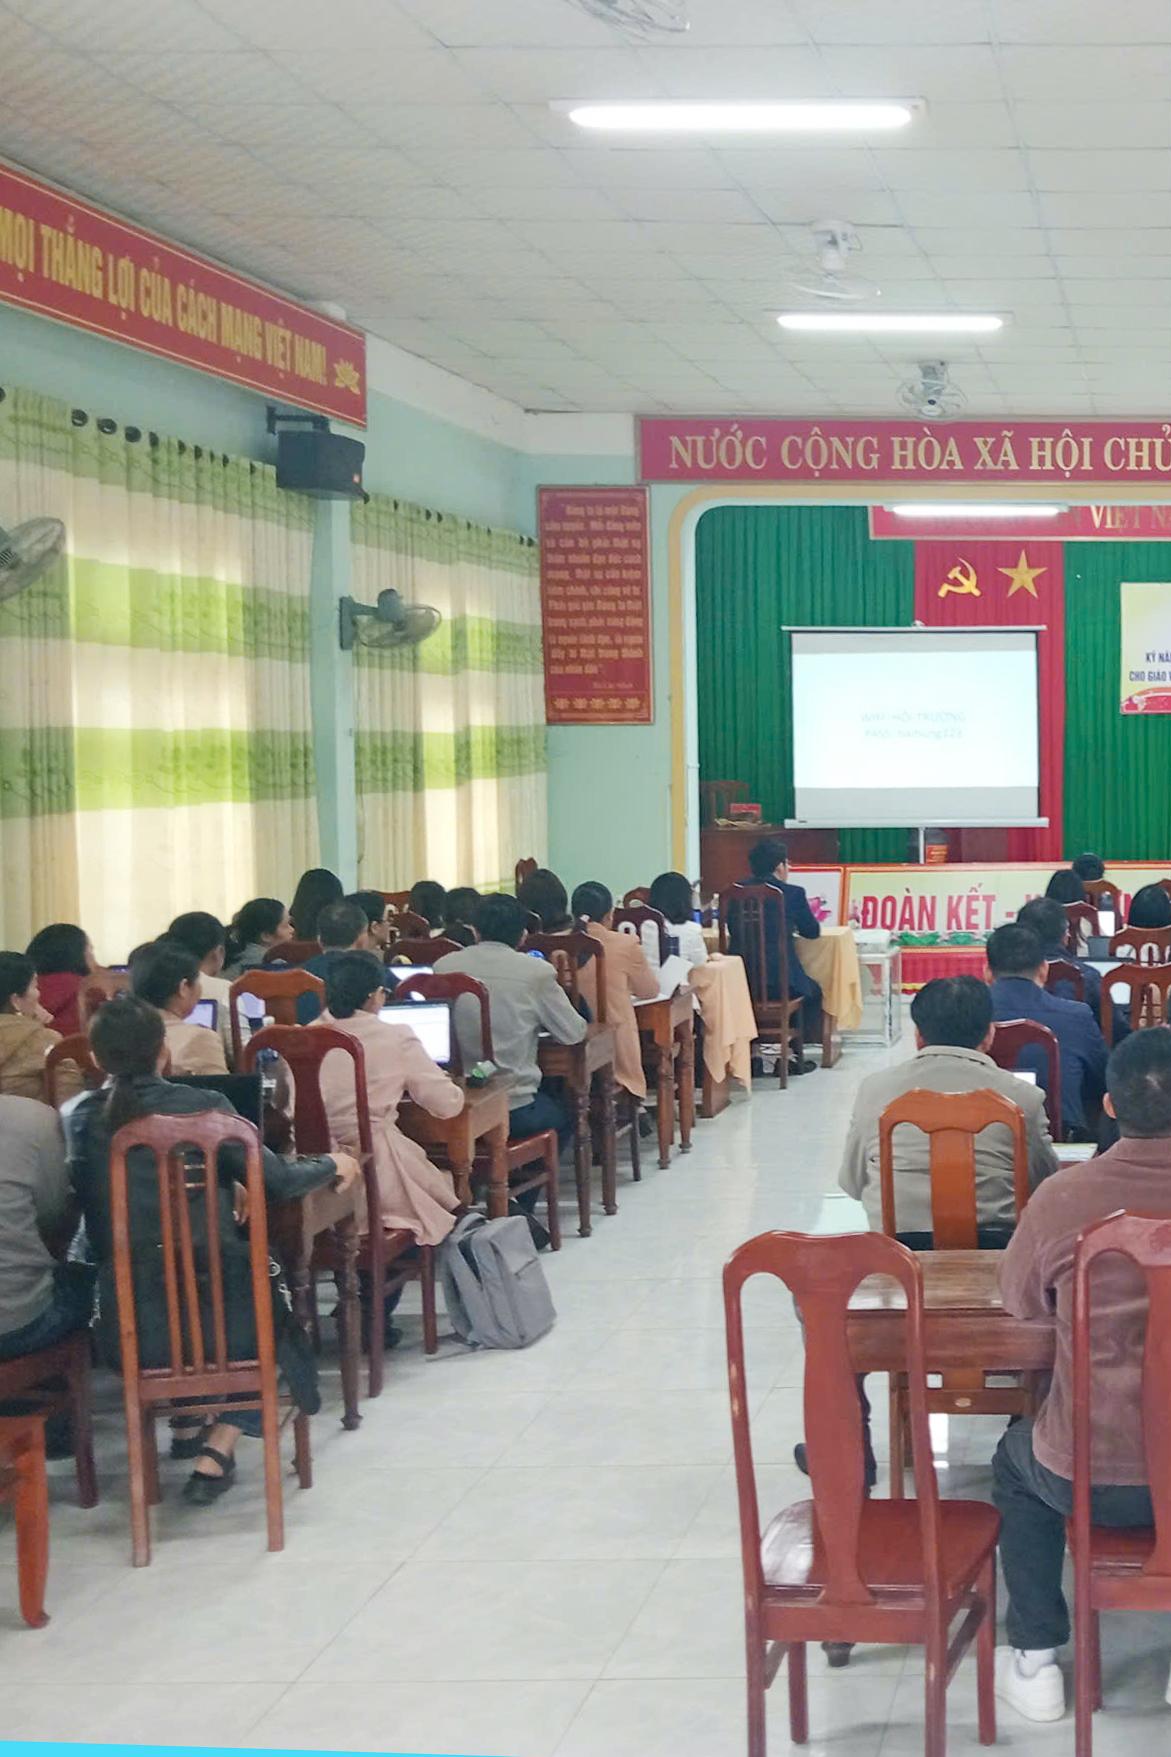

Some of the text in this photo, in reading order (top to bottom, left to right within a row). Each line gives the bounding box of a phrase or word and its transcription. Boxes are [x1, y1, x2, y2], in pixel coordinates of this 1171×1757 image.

[176, 279, 218, 345] CÁCH
[264, 318, 292, 380] VIỆT
[669, 424, 767, 470] NƯỚC
[781, 427, 881, 477] CỘNG
[891, 427, 964, 472] HÒA
[974, 430, 1019, 471] XÃ
[1029, 428, 1093, 478] HỘI
[861, 887, 937, 931] ĐOÀN
[946, 882, 996, 931] KẾT
